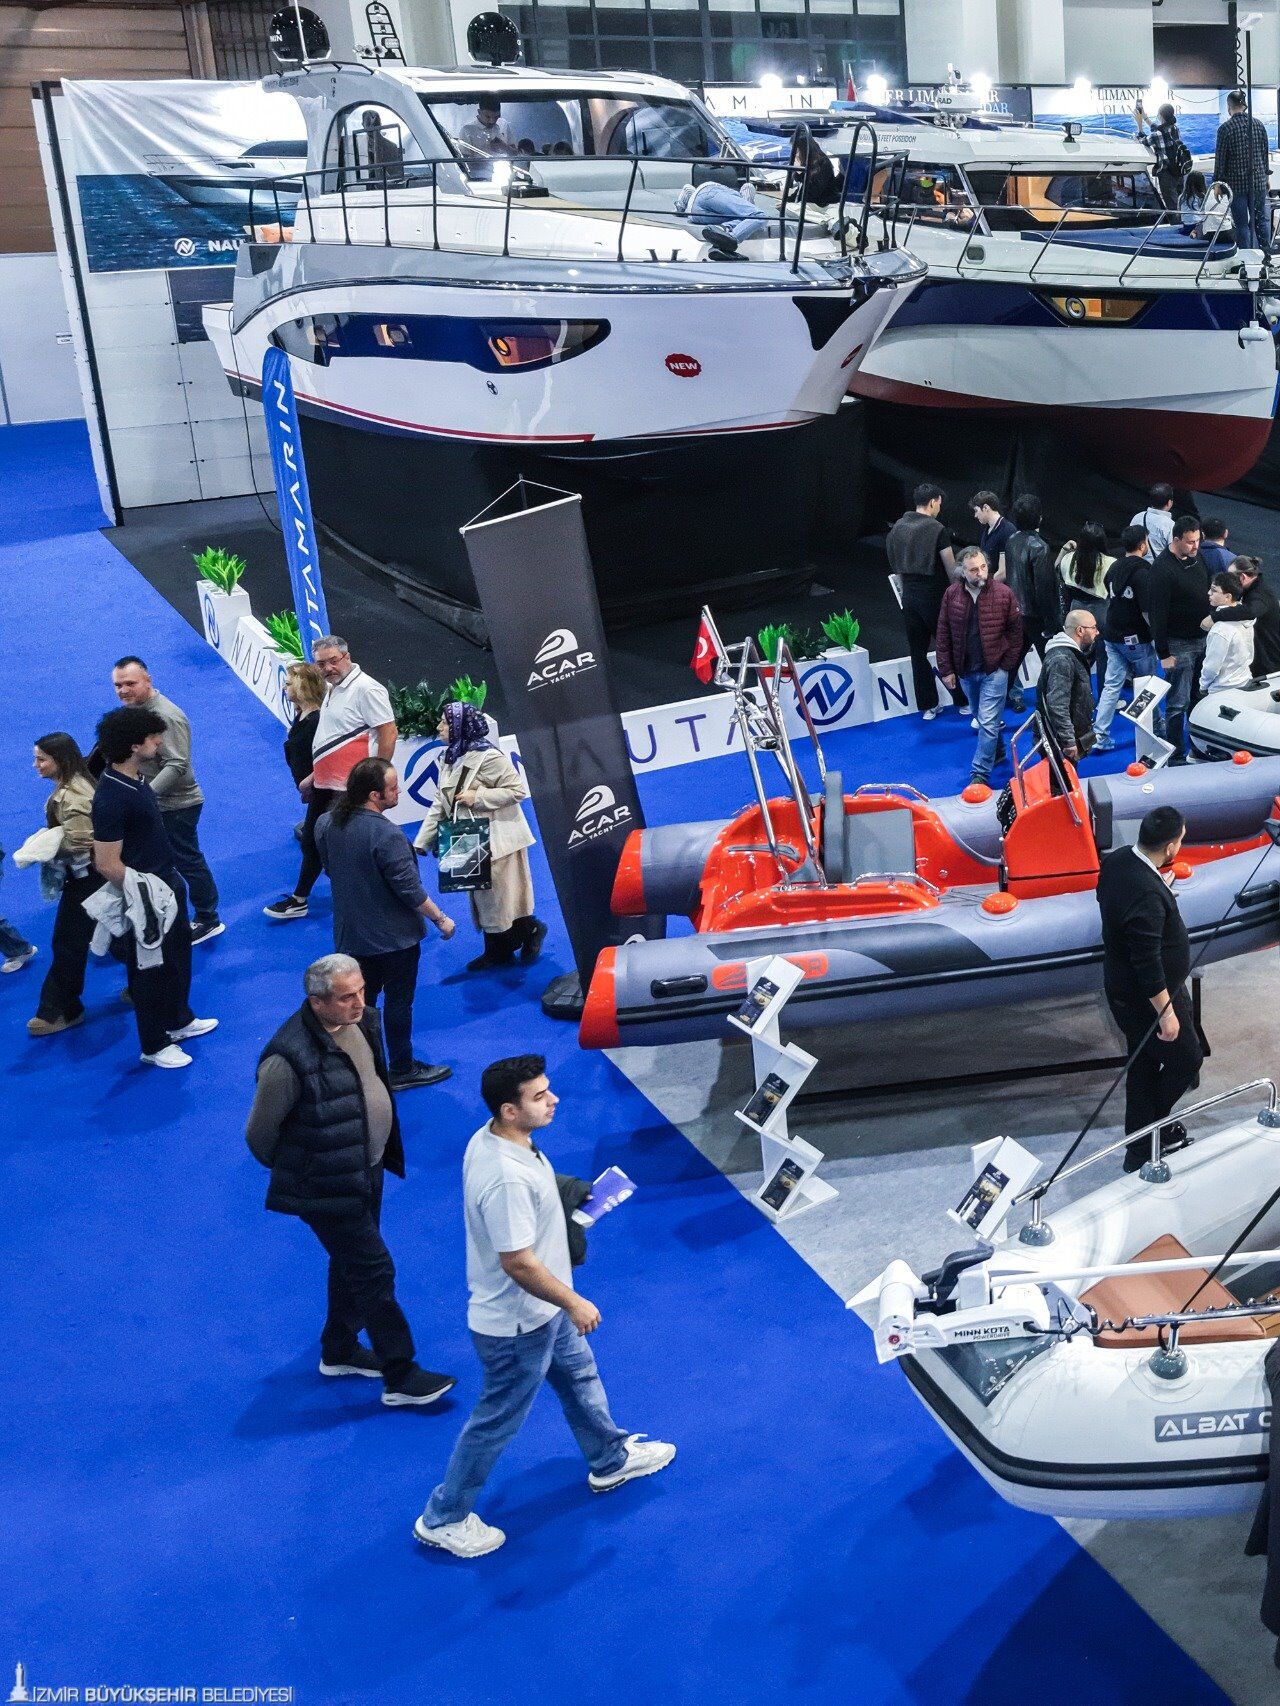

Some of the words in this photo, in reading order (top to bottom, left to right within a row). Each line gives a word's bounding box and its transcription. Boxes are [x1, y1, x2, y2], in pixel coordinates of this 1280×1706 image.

[669, 362, 698, 371] NEW
[526, 651, 596, 686] ACAR
[550, 671, 576, 684] YACHT
[567, 805, 632, 844] ACAR
[589, 825, 614, 840] YACHT
[954, 1329, 981, 1338] MINN
[983, 1326, 1011, 1334] KOTA
[1158, 1412, 1250, 1437] ALBAT
